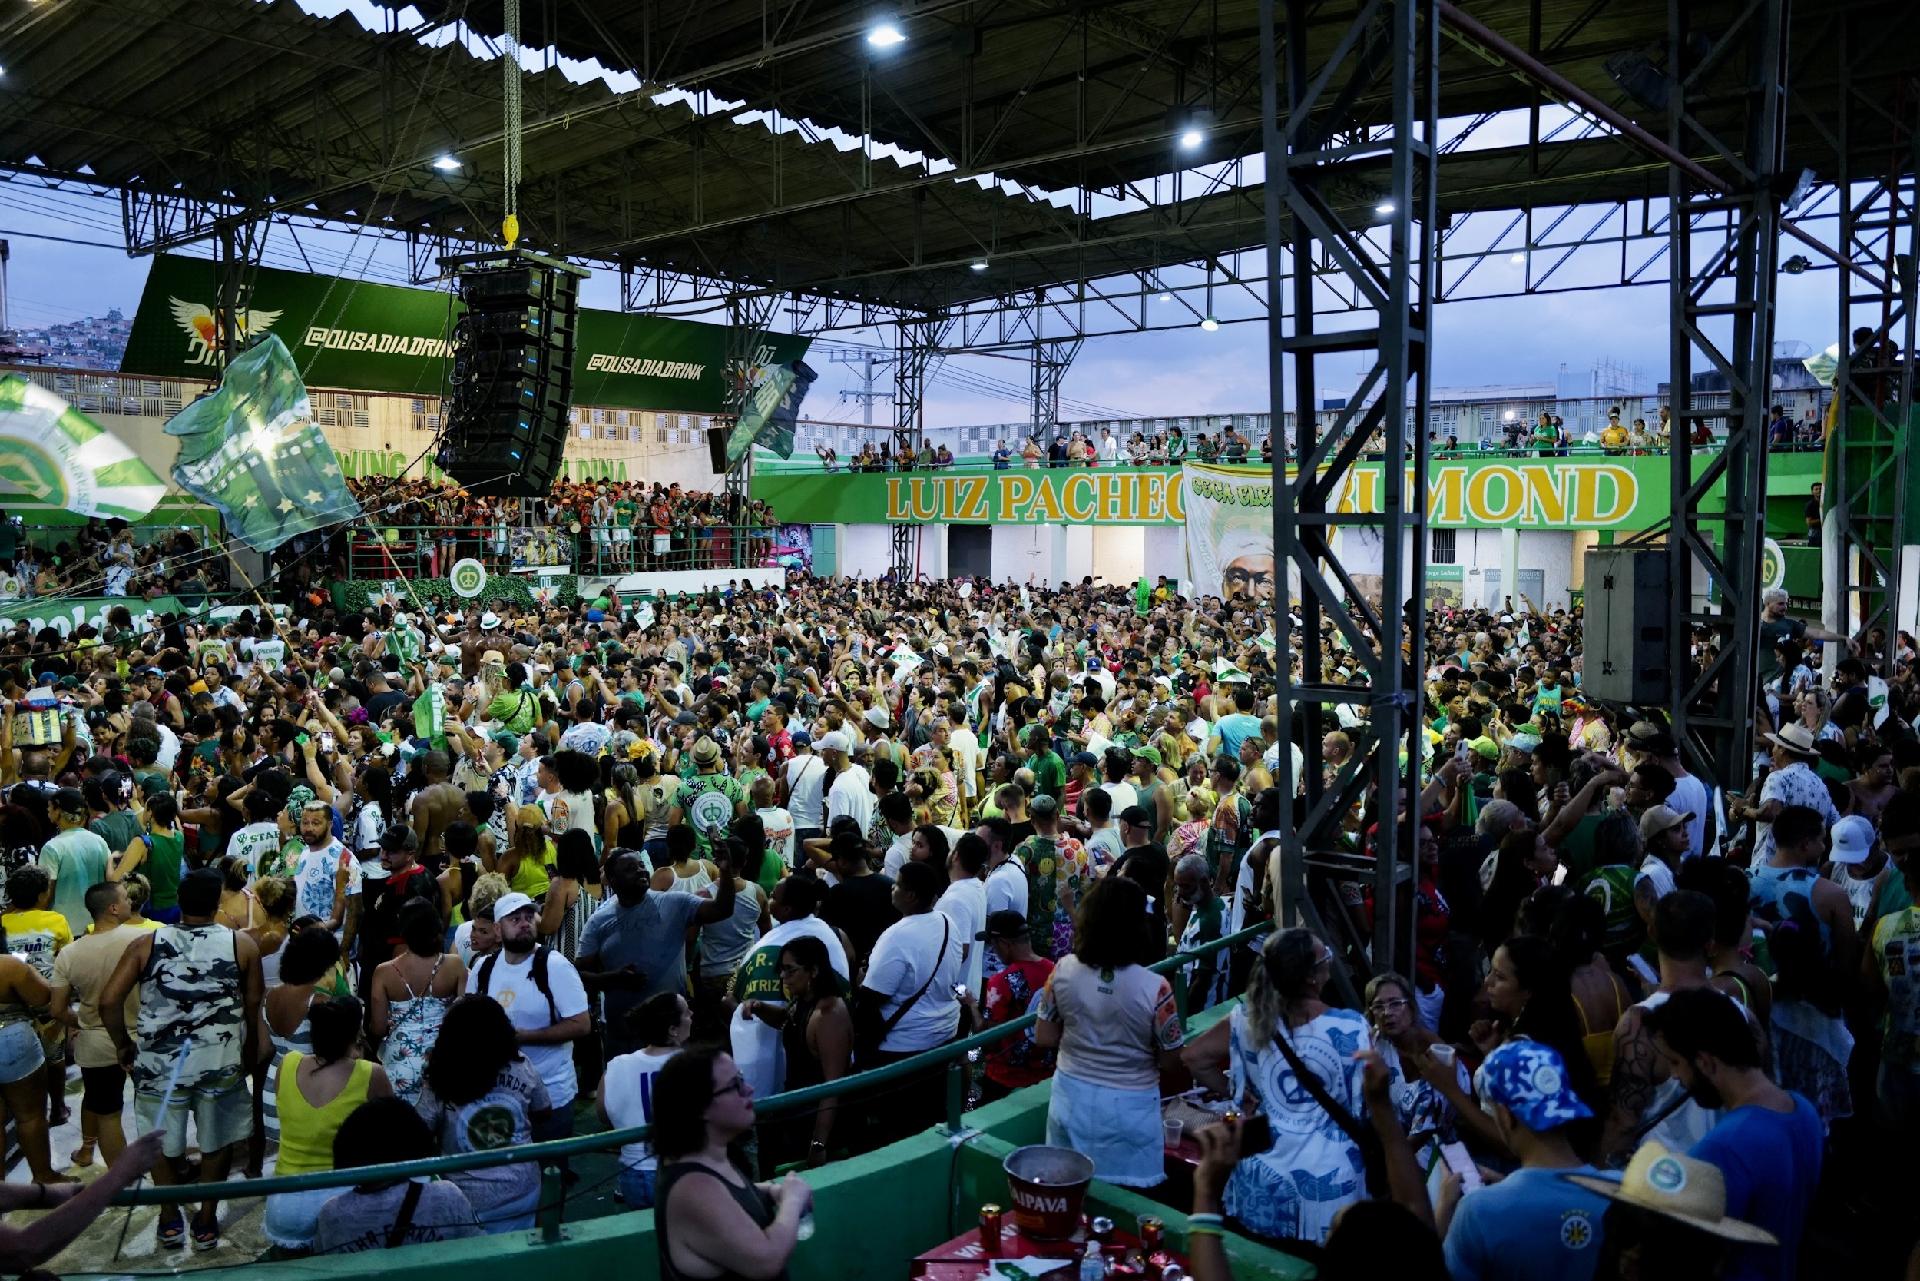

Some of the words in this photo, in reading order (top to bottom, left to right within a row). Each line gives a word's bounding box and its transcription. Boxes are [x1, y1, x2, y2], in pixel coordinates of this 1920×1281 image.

[586, 353, 706, 381] @OUSADIADRINK
[333, 449, 406, 481] WING
[886, 475, 989, 521] LUIZ
